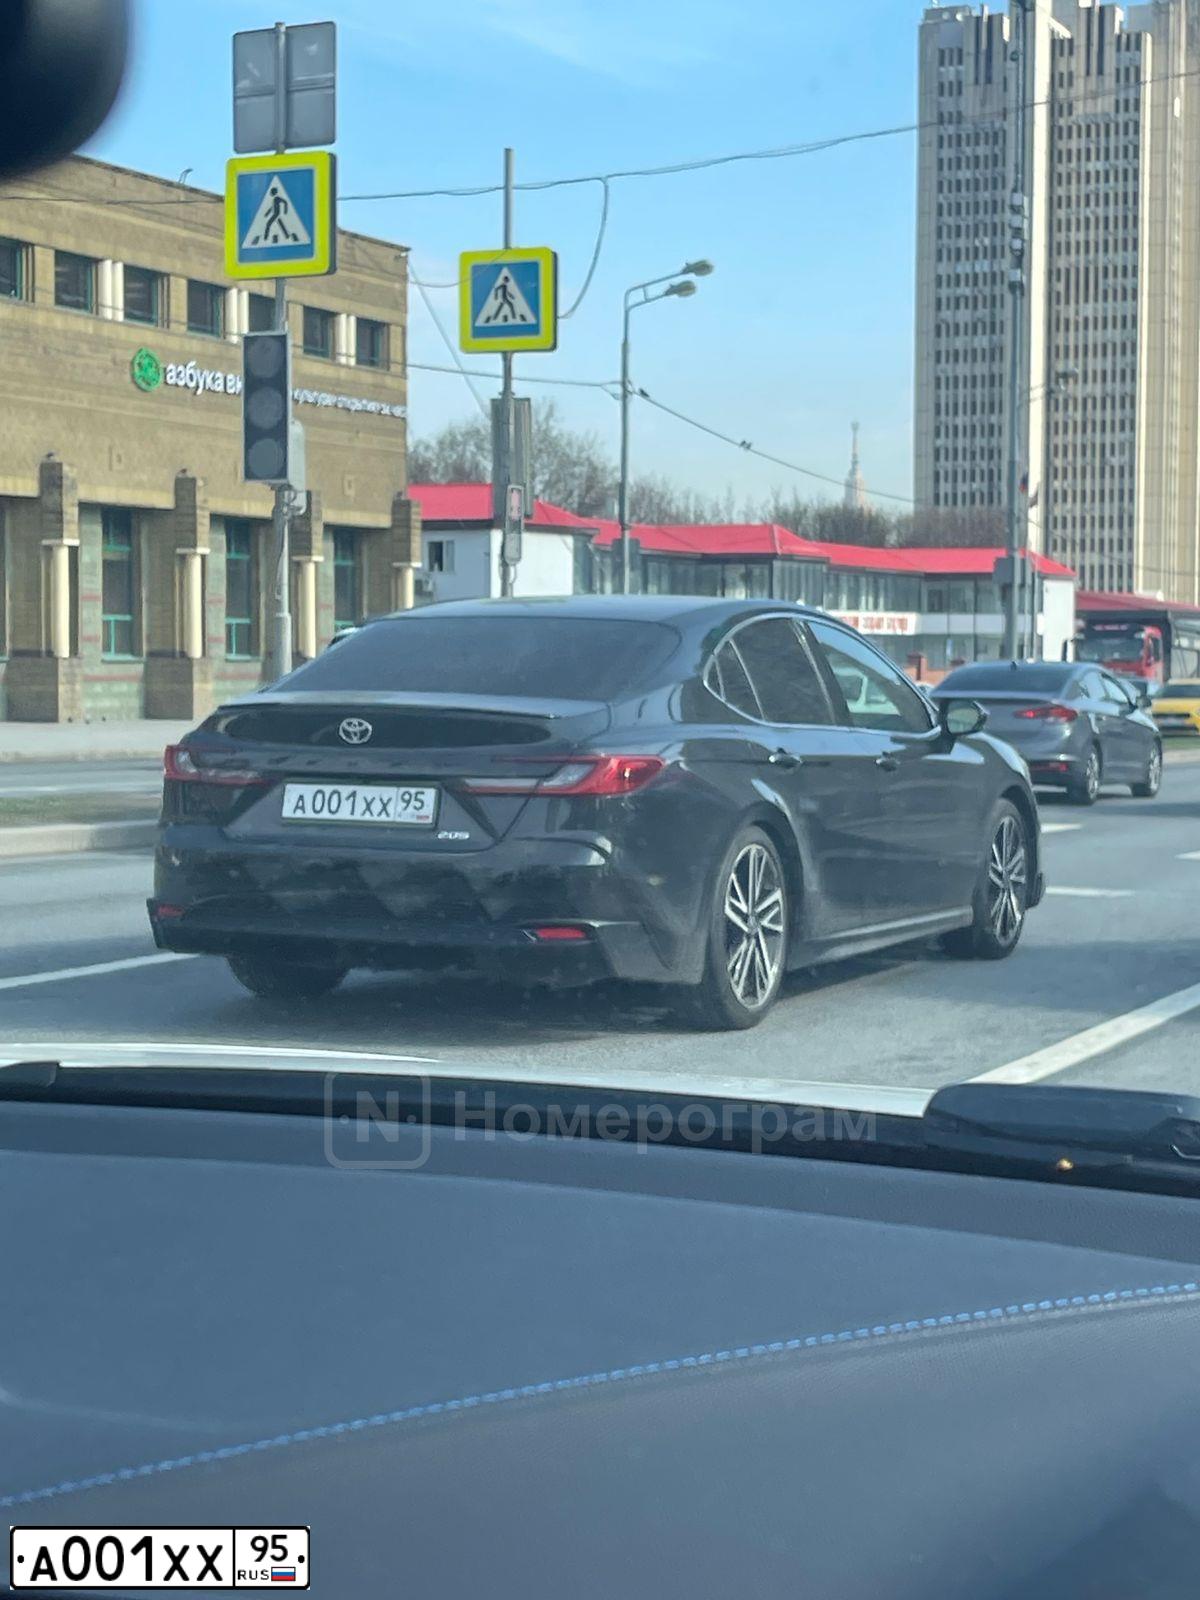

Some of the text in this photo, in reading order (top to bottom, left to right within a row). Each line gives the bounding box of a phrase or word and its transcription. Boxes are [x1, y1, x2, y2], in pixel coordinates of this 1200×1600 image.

[166, 361, 225, 396] азбука
[293, 789, 425, 817] А001ХХ 95
